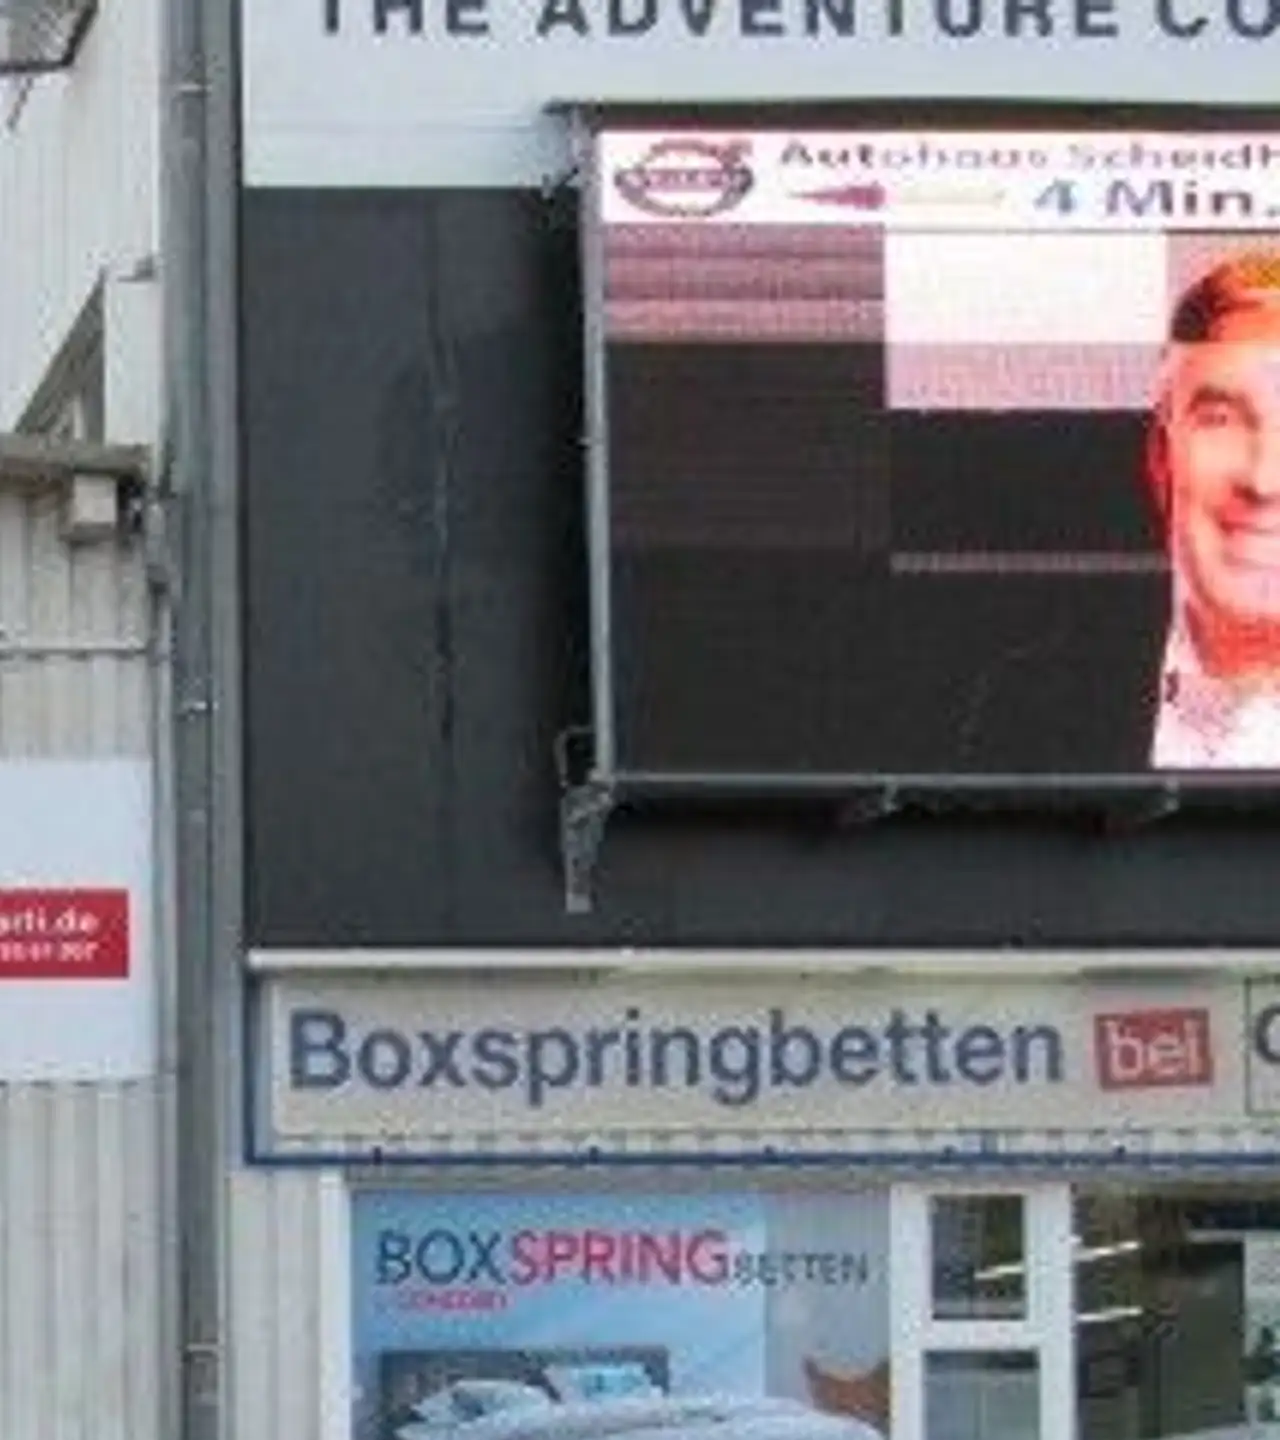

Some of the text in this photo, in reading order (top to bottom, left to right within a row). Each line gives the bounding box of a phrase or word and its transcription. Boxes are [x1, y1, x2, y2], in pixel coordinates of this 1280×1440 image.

[324, 0, 490, 37] THE
[536, 0, 1119, 38] ADVENTURE
[1034, 178, 1280, 217] 4 Min.
[290, 1007, 1065, 1107] Boxspringbetten
